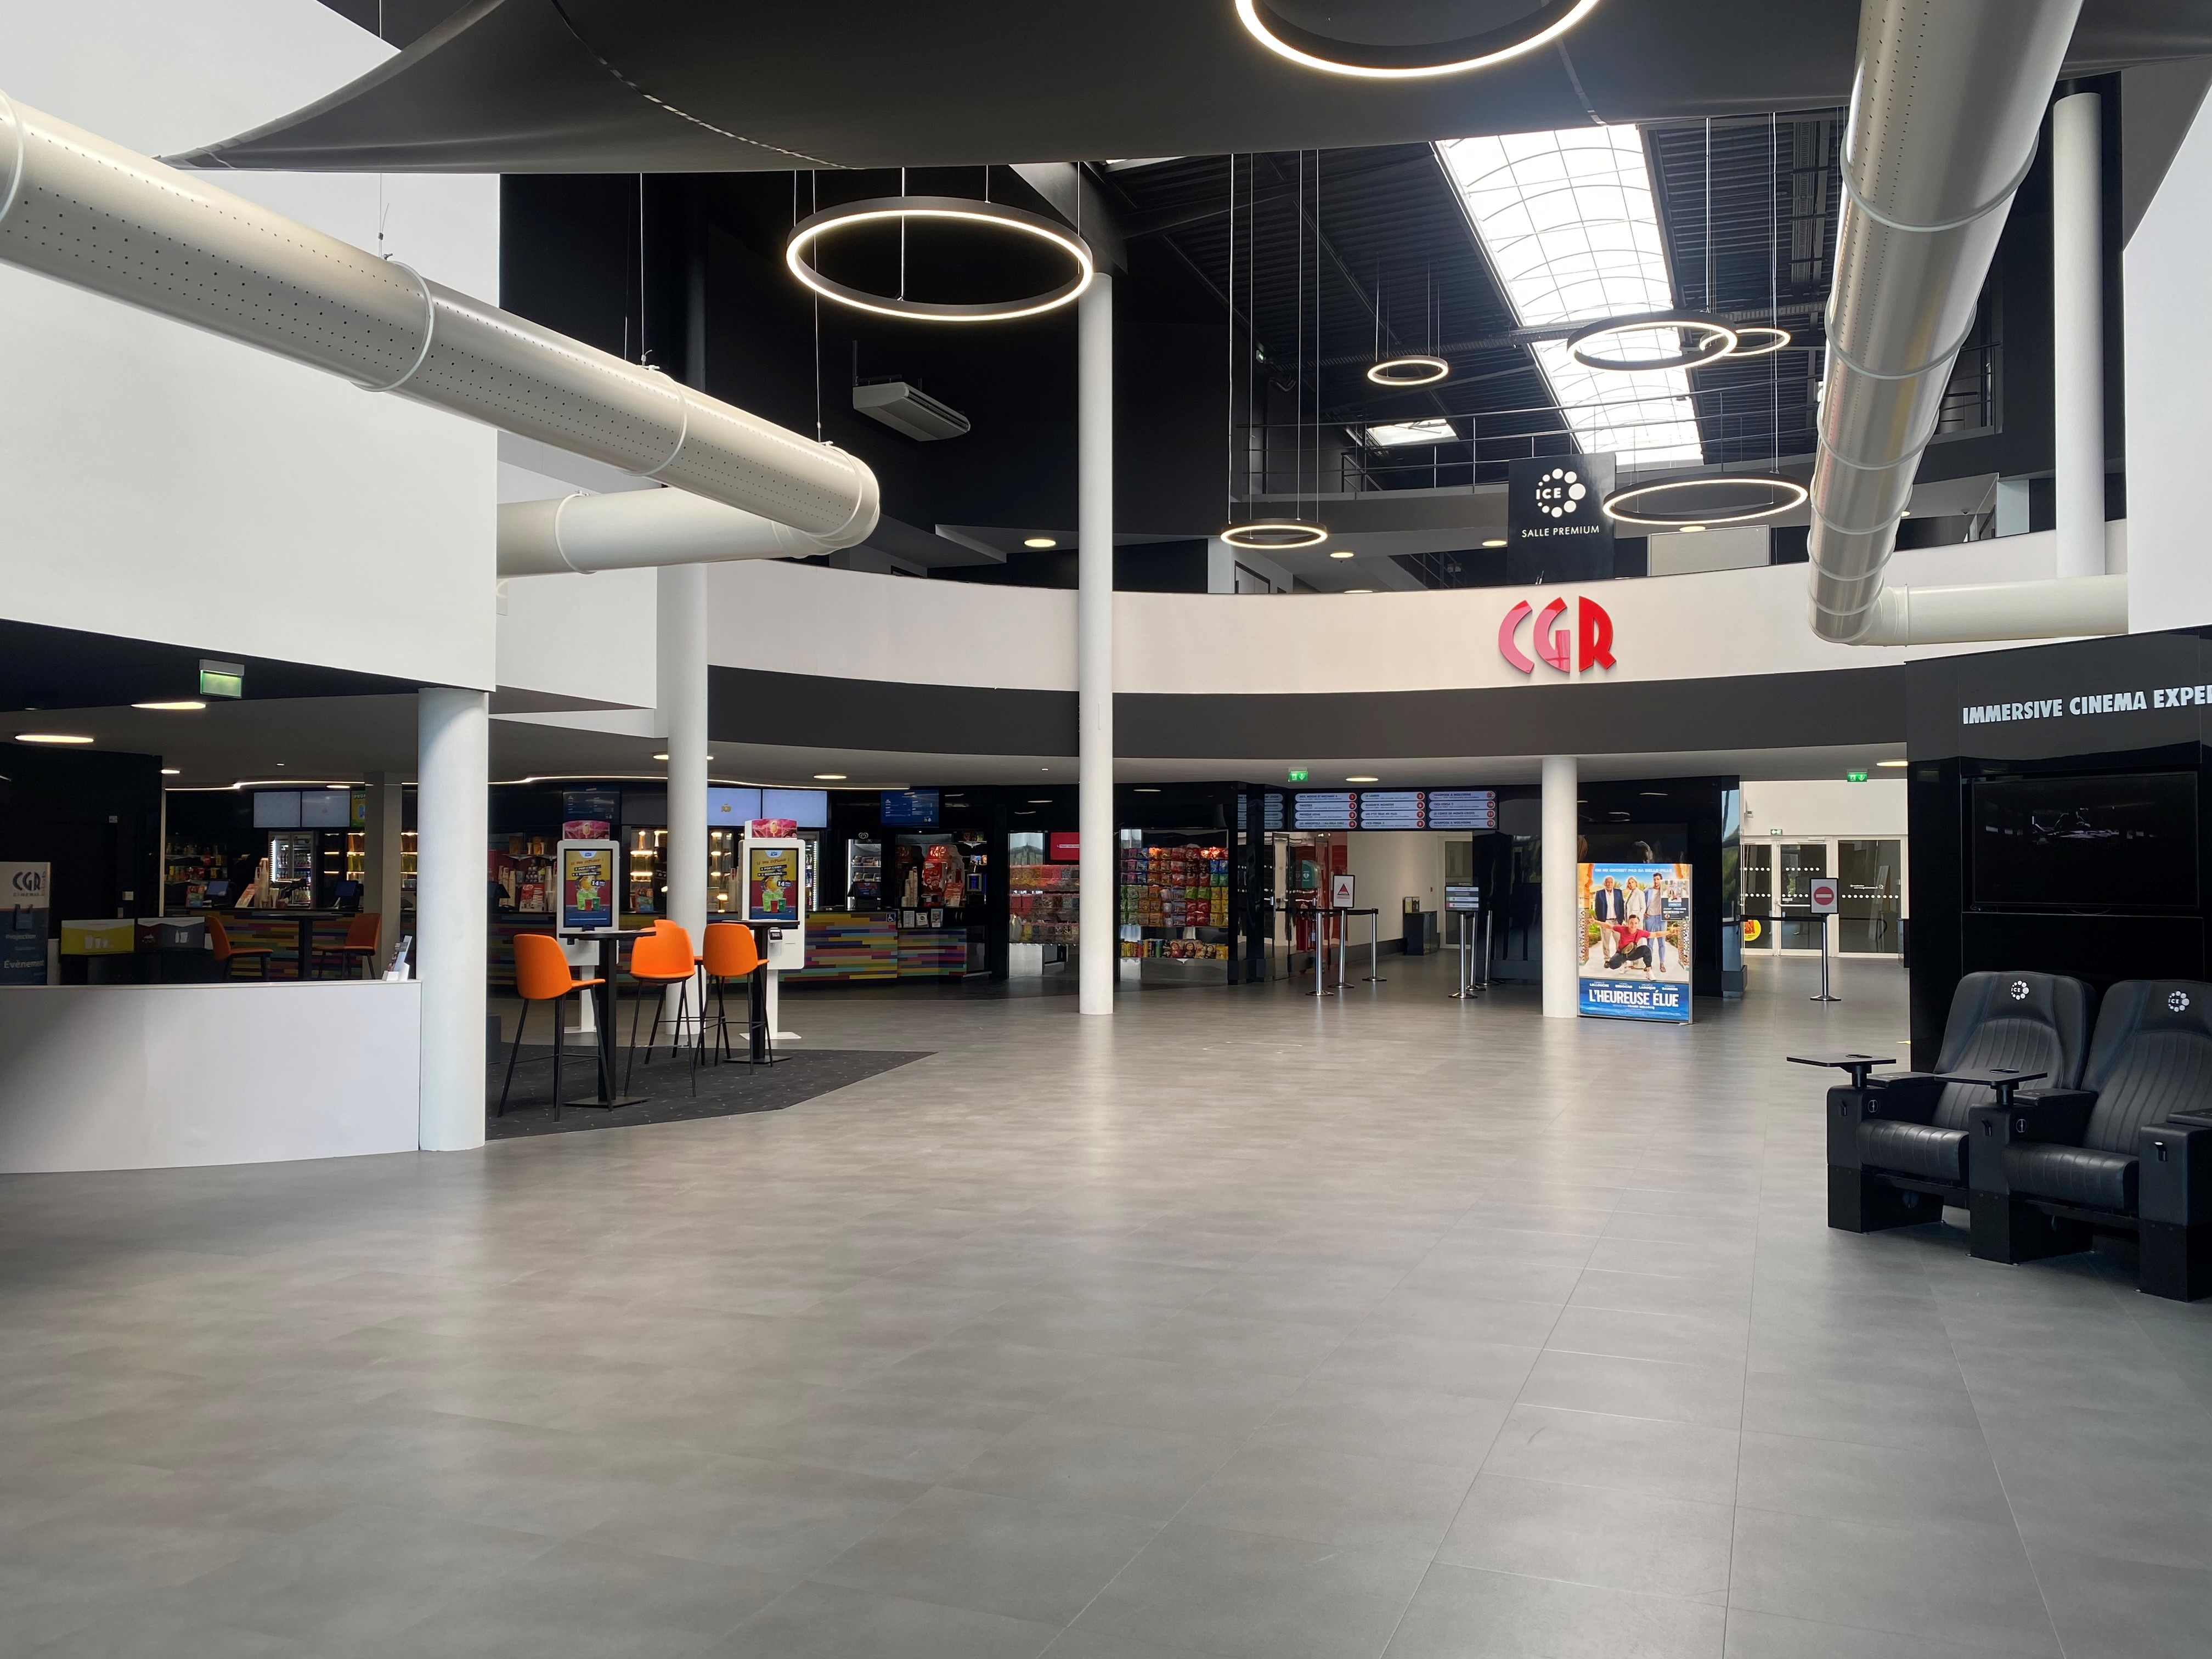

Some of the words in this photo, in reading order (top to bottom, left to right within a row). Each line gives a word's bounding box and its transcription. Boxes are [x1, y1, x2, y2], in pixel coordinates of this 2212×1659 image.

[1536, 487, 1562, 500] ICE
[1521, 527, 1550, 538] SALLE
[1553, 524, 1600, 536] PREMIUM
[1498, 595, 1617, 674] CGR
[1962, 698, 2063, 724] IMMERSIVE
[2069, 691, 2147, 714] CINEMA
[13, 871, 41, 891] CGR
[1652, 989, 1679, 1007] ÉLUE
